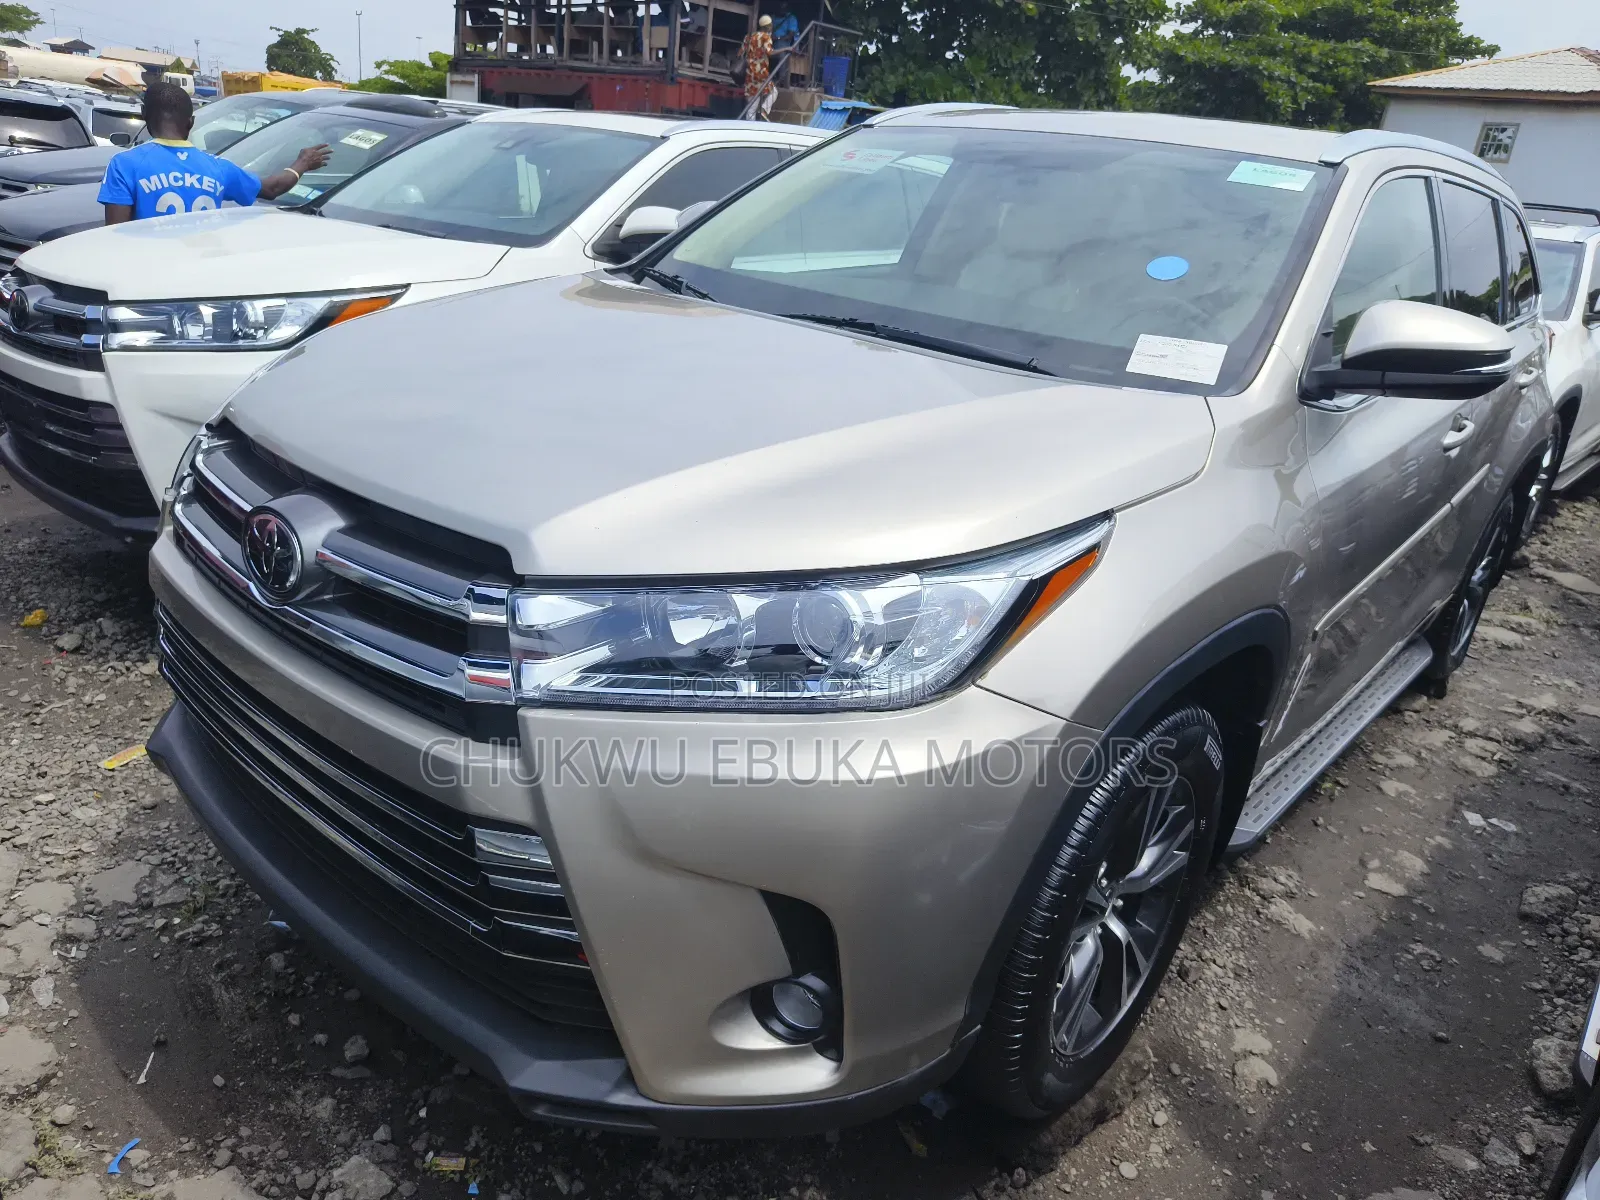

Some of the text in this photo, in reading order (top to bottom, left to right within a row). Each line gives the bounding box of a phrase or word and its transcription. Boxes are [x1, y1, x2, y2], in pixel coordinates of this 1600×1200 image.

[348, 133, 377, 144] LAGOS
[139, 171, 224, 196] MICKEY
[1203, 734, 1222, 770] PIRELLI
